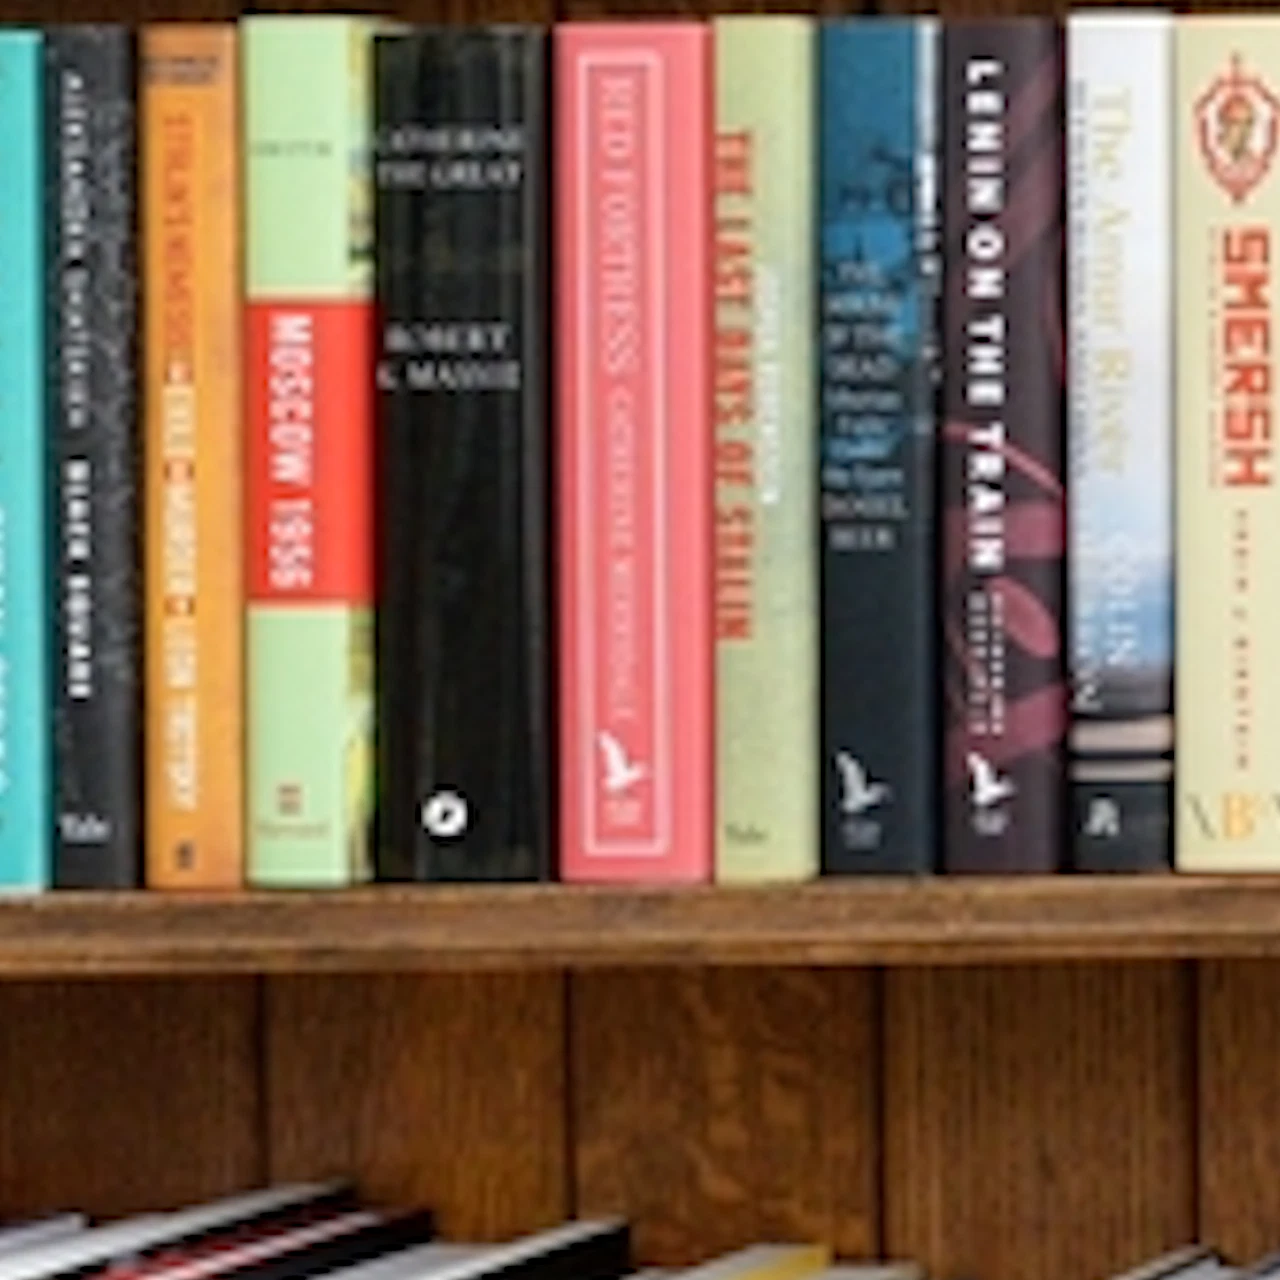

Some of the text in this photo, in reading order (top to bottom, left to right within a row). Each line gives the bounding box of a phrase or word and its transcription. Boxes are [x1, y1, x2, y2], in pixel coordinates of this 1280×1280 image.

[966, 60, 1005, 213] LENIN
[1092, 86, 1133, 179] The
[601, 76, 640, 374] RED FORTRESS
[966, 224, 1006, 300] ON
[967, 316, 1005, 407] THE
[1224, 229, 1272, 488] SMERSH
[269, 314, 315, 589] MOSCOW 1956
[967, 422, 1005, 569] TRAIN
